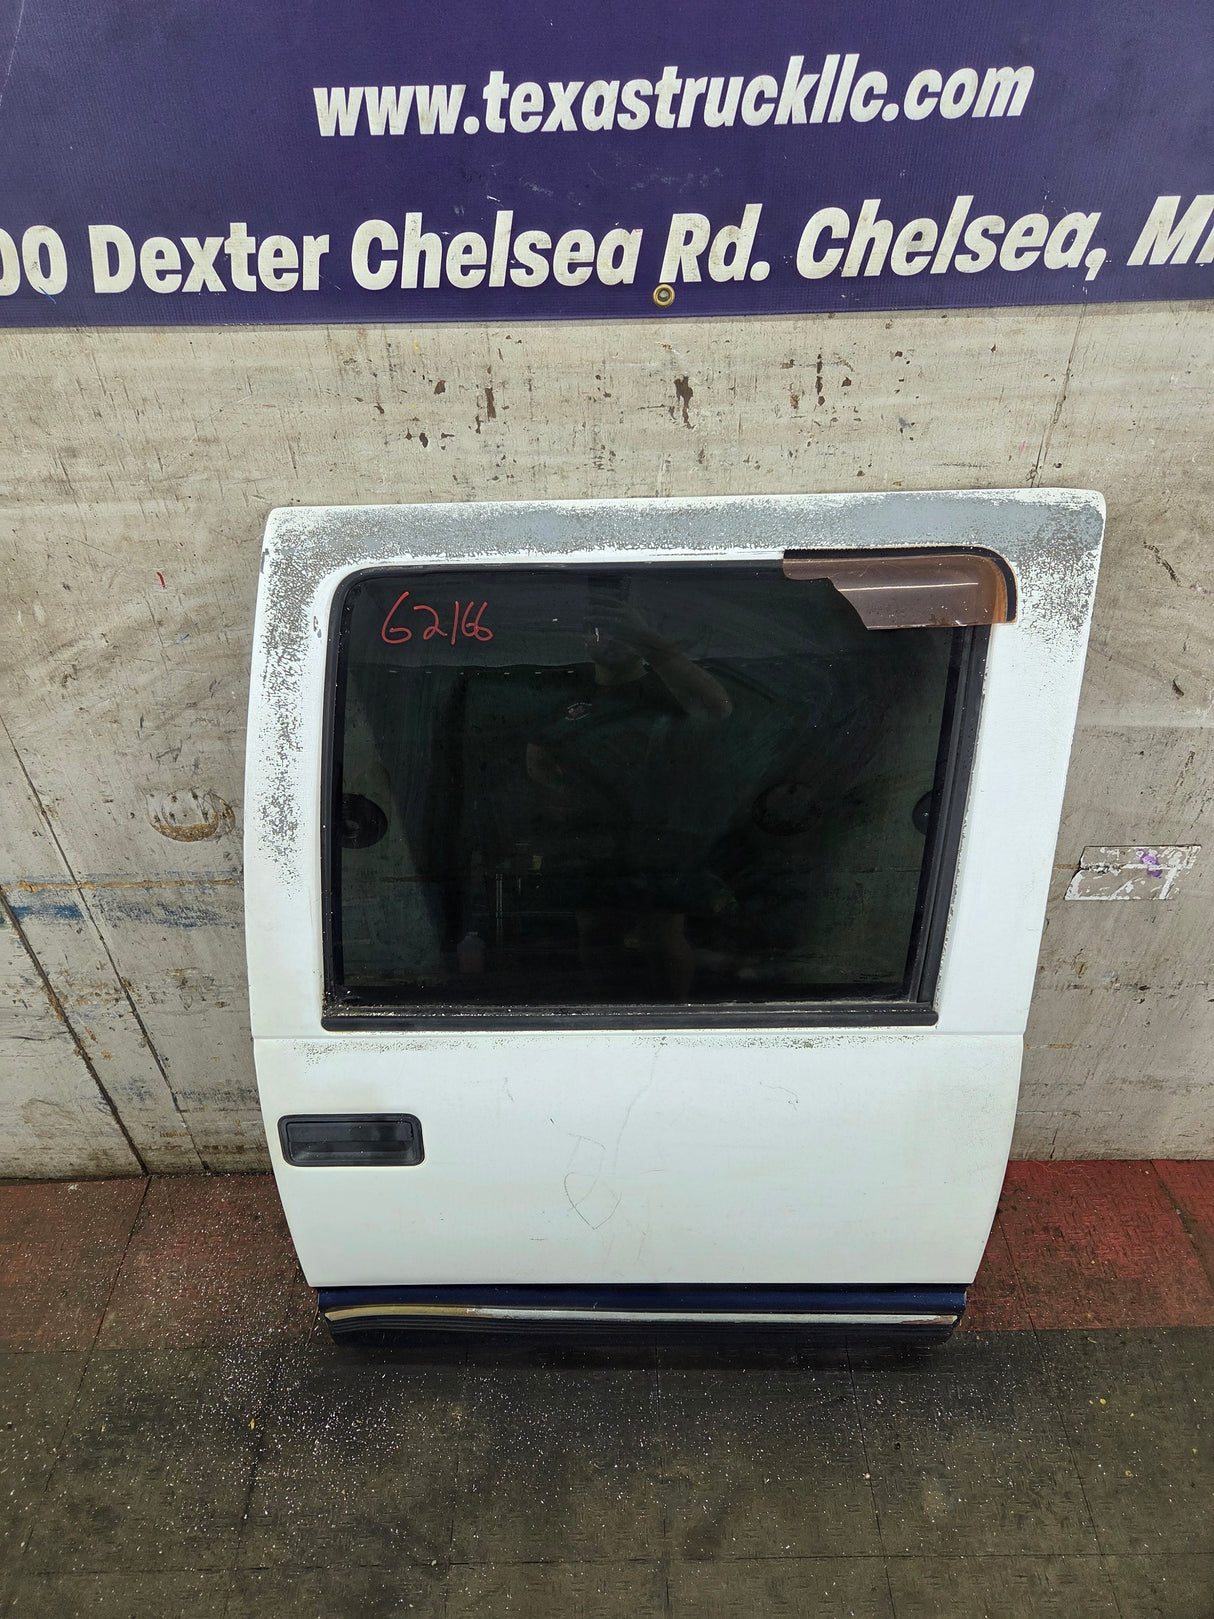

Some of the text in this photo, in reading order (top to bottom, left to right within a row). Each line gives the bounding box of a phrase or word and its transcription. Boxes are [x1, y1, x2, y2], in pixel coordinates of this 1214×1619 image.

[313, 54, 1034, 137] www.texastruckllc.com
[88, 222, 329, 294] Dexter
[351, 210, 643, 291] Chelsea
[659, 204, 770, 283] Rd.
[797, 195, 1106, 281] Chelsea,
[381, 591, 494, 645] 62166
